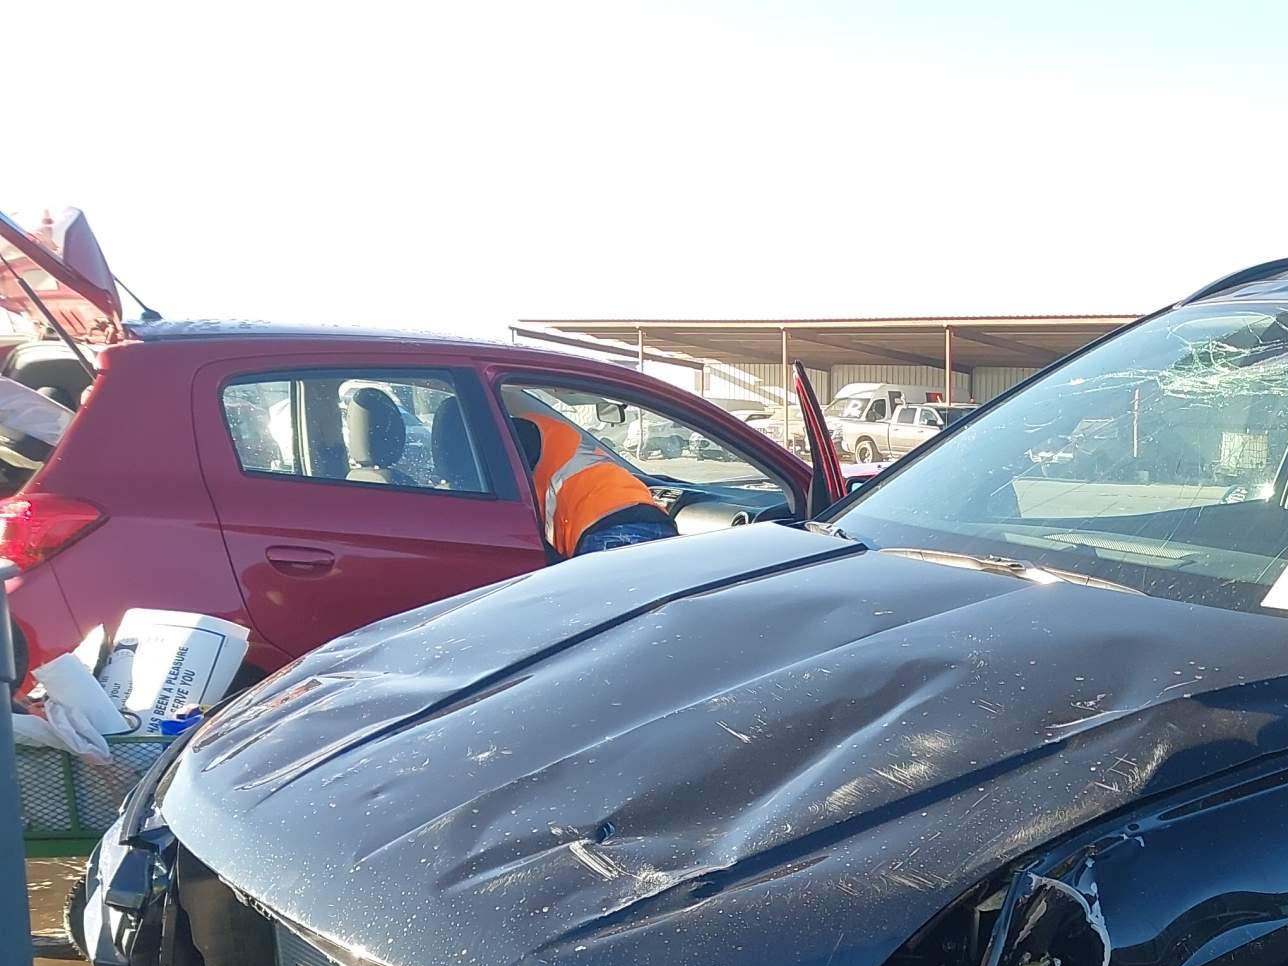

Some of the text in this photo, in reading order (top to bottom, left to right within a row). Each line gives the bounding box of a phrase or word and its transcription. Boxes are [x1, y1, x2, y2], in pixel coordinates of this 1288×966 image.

[153, 694, 170, 716] BEEN
[165, 646, 189, 685] PLEASURE
[180, 669, 196, 687] YOU
